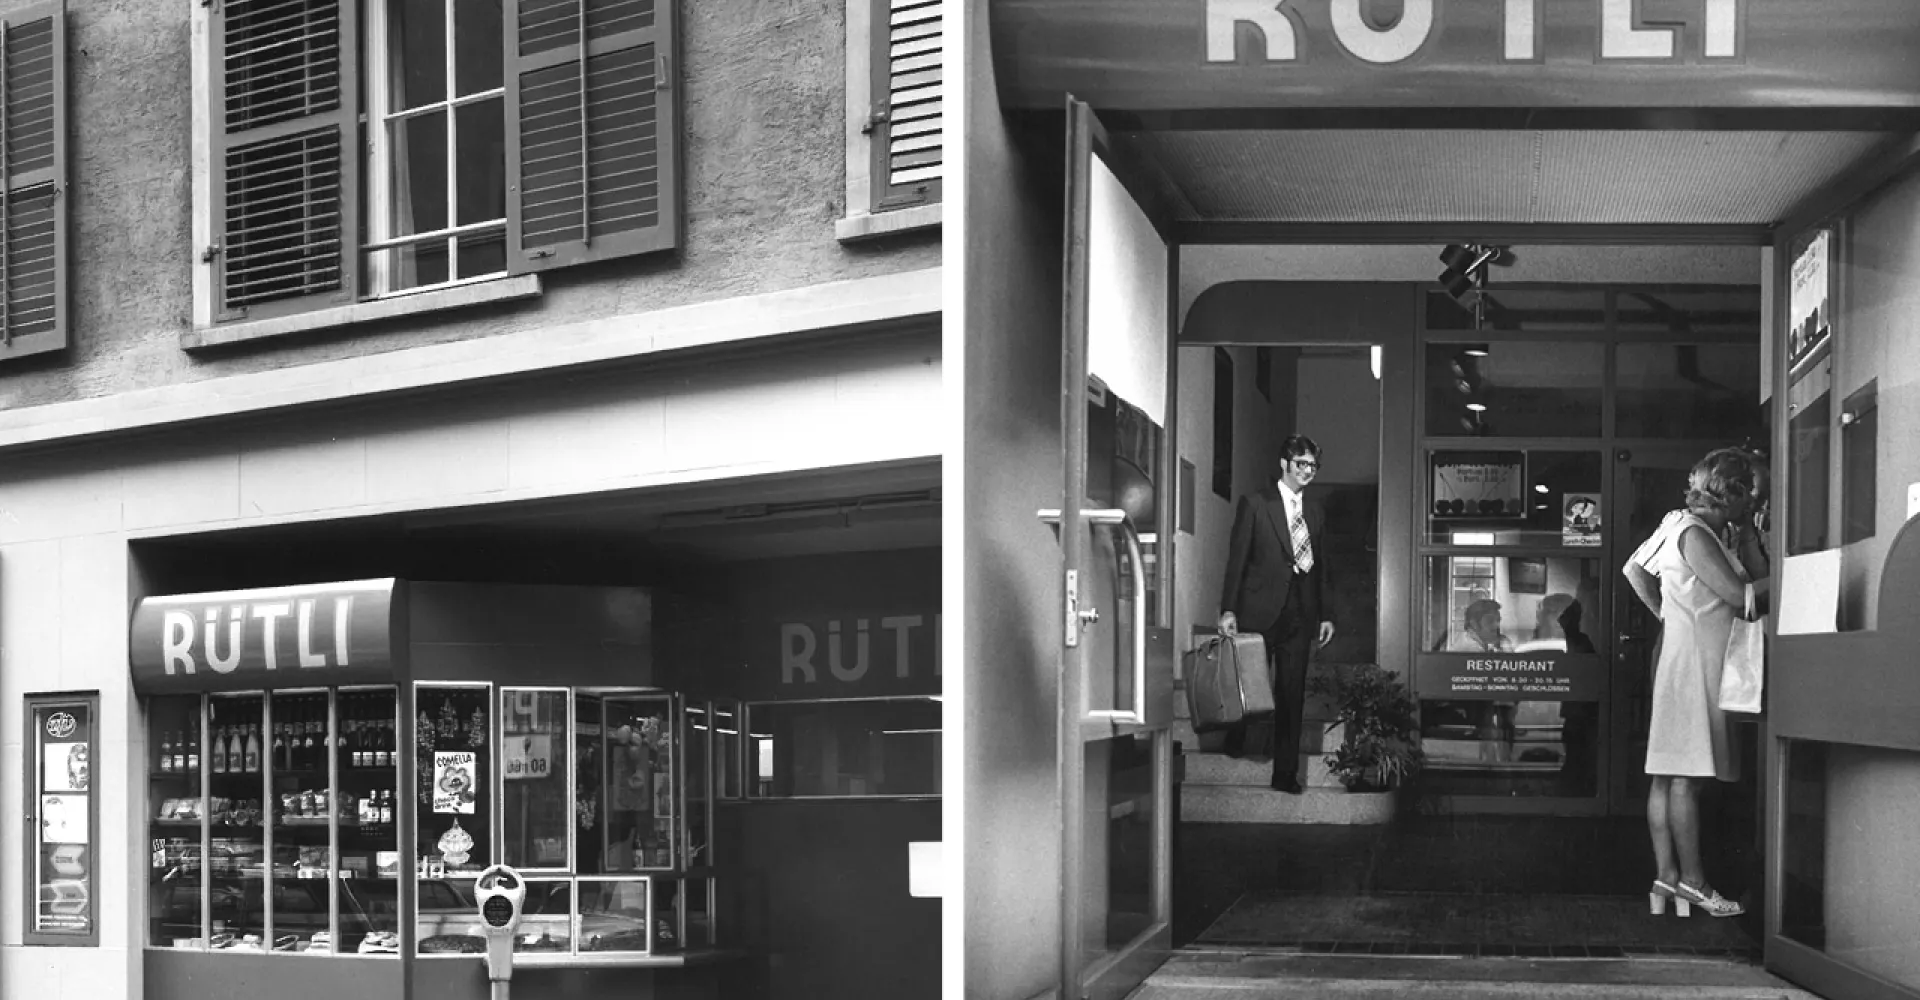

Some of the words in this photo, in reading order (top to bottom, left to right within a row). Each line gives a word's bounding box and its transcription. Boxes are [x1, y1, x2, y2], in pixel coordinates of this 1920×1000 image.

[164, 598, 351, 675] RÜTLI
[1466, 659, 1555, 671] RESTAURANT
[436, 753, 472, 768] COMELLA
